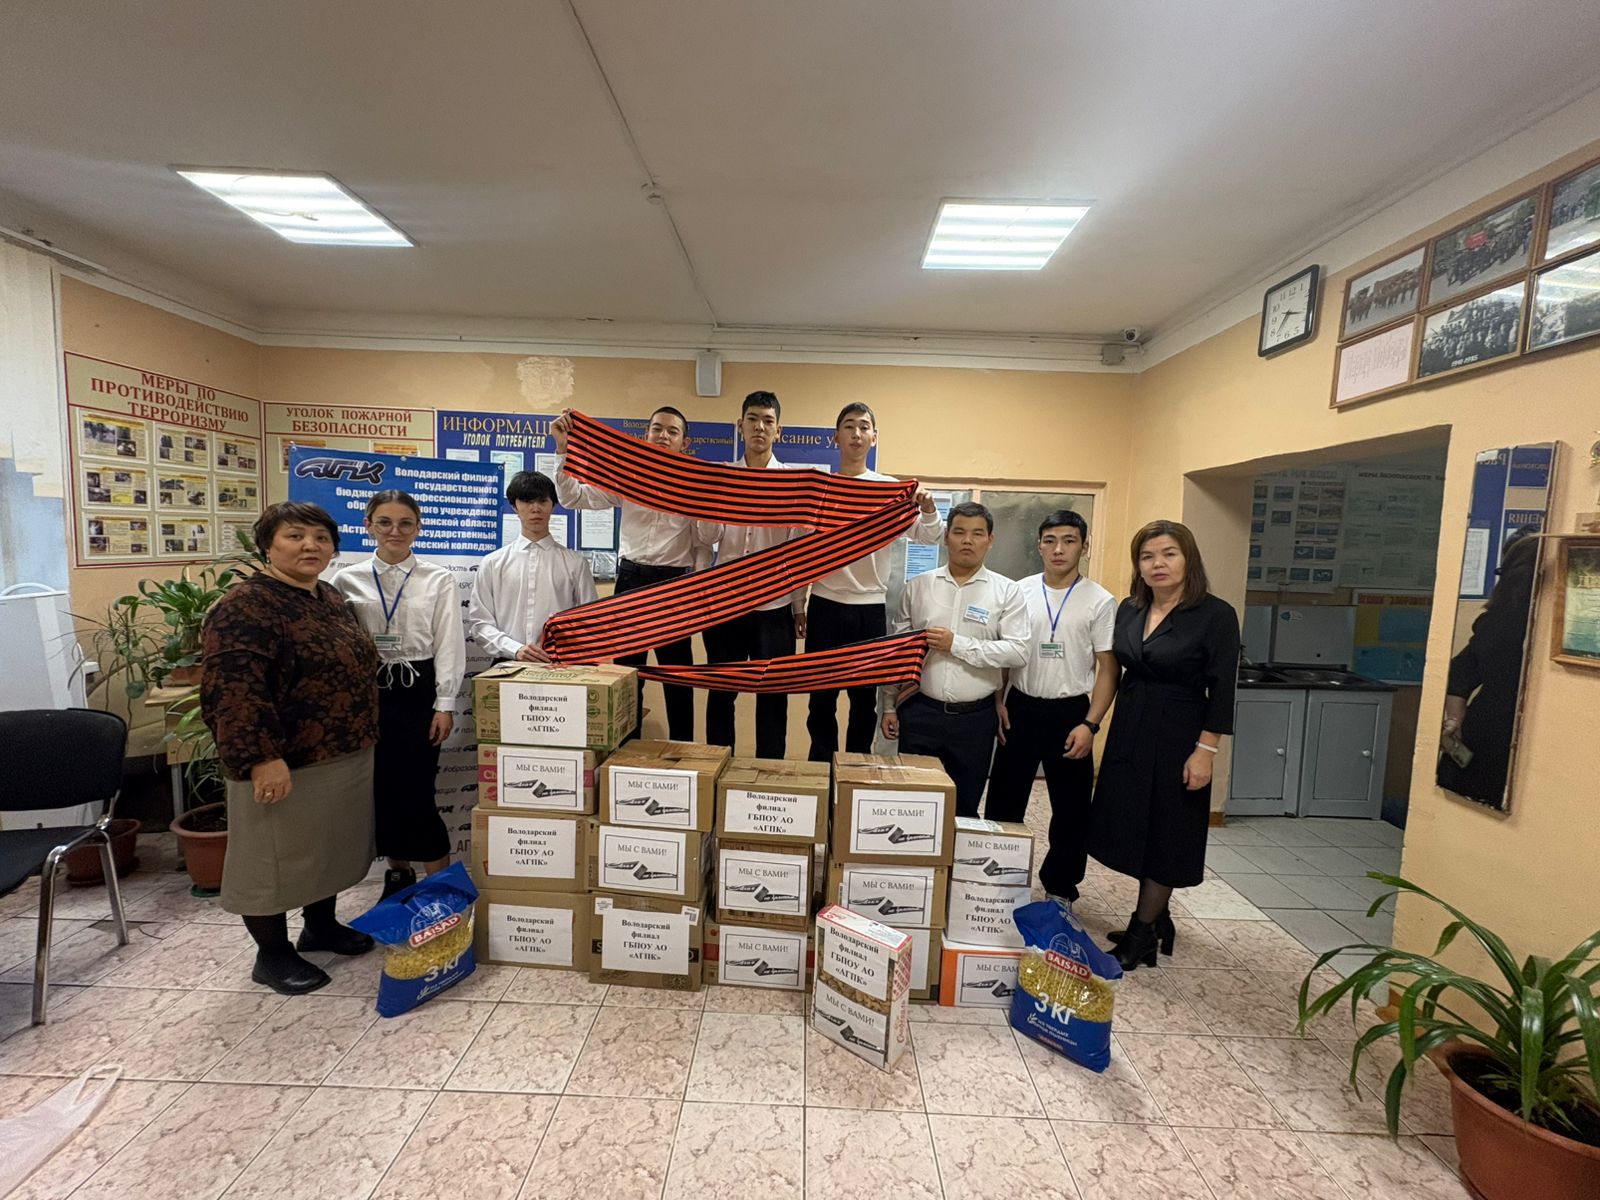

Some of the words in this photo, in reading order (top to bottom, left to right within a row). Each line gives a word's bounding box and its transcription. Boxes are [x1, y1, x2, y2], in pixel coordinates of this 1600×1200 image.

[141, 373, 189, 396] МЕРЫ
[197, 385, 216, 402] ПО
[91, 377, 249, 423] ПРОТИВОДЕЙСТВИЮ
[128, 401, 227, 431] ТЕРРОРИЗМУ
[286, 407, 335, 419] УГОЛОК
[341, 409, 412, 423] ПОЖАРНОЙ
[292, 420, 407, 437] БЕЗОПАСНОСТИ
[443, 416, 554, 437] ИНФОРМАЦ
[462, 432, 491, 447] УГОЛОК
[495, 434, 546, 449] ПОТРЕБИТЕЛЯ
[394, 467, 460, 481] Володарский
[461, 471, 499, 483] филиал
[414, 482, 498, 495] государственного
[440, 506, 498, 518] учреждения
[459, 518, 497, 529] области
[418, 528, 496, 540] осударственный
[518, 692, 568, 703] Володарский
[528, 704, 557, 713] филиал
[521, 714, 551, 722] ГБПОУ
[527, 725, 560, 733] «АГПК»
[516, 763, 531, 772] МЫ
[539, 766, 566, 774] ВАМИ!
[627, 780, 643, 789] МЫ
[644, 781, 651, 789] С
[652, 782, 679, 791] ВАМИ!
[746, 791, 798, 803] Володарский
[756, 803, 787, 812] филиал
[872, 807, 887, 816] МЫ
[889, 808, 897, 816] С
[897, 809, 925, 817] ВАМИ!
[747, 813, 779, 822] ГБПОУ
[780, 816, 794, 824] АО
[507, 827, 557, 836] Володарский
[753, 824, 787, 833] «АГПК»
[517, 838, 547, 846] филиал
[967, 839, 983, 849] МЫ
[984, 841, 992, 850] С
[992, 842, 1020, 852] ВАМИ!
[509, 848, 539, 856] ГБПОУ
[617, 844, 632, 853] МЫ
[633, 845, 640, 853] С
[641, 846, 667, 856] ВАМИ!
[515, 858, 548, 866] «АГПК»
[738, 867, 753, 875] МЫ
[754, 868, 761, 876] С
[762, 869, 789, 878] ВАМИ!
[862, 880, 878, 889] МЫ
[879, 881, 887, 889] С
[887, 882, 915, 891] ВАМИ!
[964, 893, 1015, 904] Володарский
[974, 904, 1004, 914] филиал
[506, 915, 555, 925] Володарский
[621, 919, 671, 930] Володарский
[965, 914, 997, 924] ГБПОУ
[997, 917, 1011, 925] АО
[413, 916, 459, 943] BAISAD
[516, 926, 544, 934] филиал
[970, 925, 1004, 934] «АГПК»
[508, 935, 537, 943] ГБПОУ
[631, 931, 660, 940] филиал
[829, 926, 879, 954] Володарский
[623, 941, 652, 950] ГБПОУ
[654, 944, 668, 952] АО
[738, 942, 753, 951] МЫ
[754, 943, 761, 951] С
[762, 944, 789, 953] ВАМИ!
[628, 953, 662, 961] «АГПК»
[838, 943, 868, 962] филиал
[830, 951, 860, 970] ГБПОУ
[861, 966, 875, 978] АО
[976, 963, 992, 972] МЫ
[993, 964, 1000, 972] С
[1001, 964, 1019, 973] ВАМ
[424, 965, 439, 982] 3
[835, 968, 868, 987] «АГПК»
[1034, 991, 1050, 1013] 3
[825, 993, 840, 1009] МЫ
[840, 1001, 847, 1012] С
[848, 1005, 875, 1027] ВАМИ!
